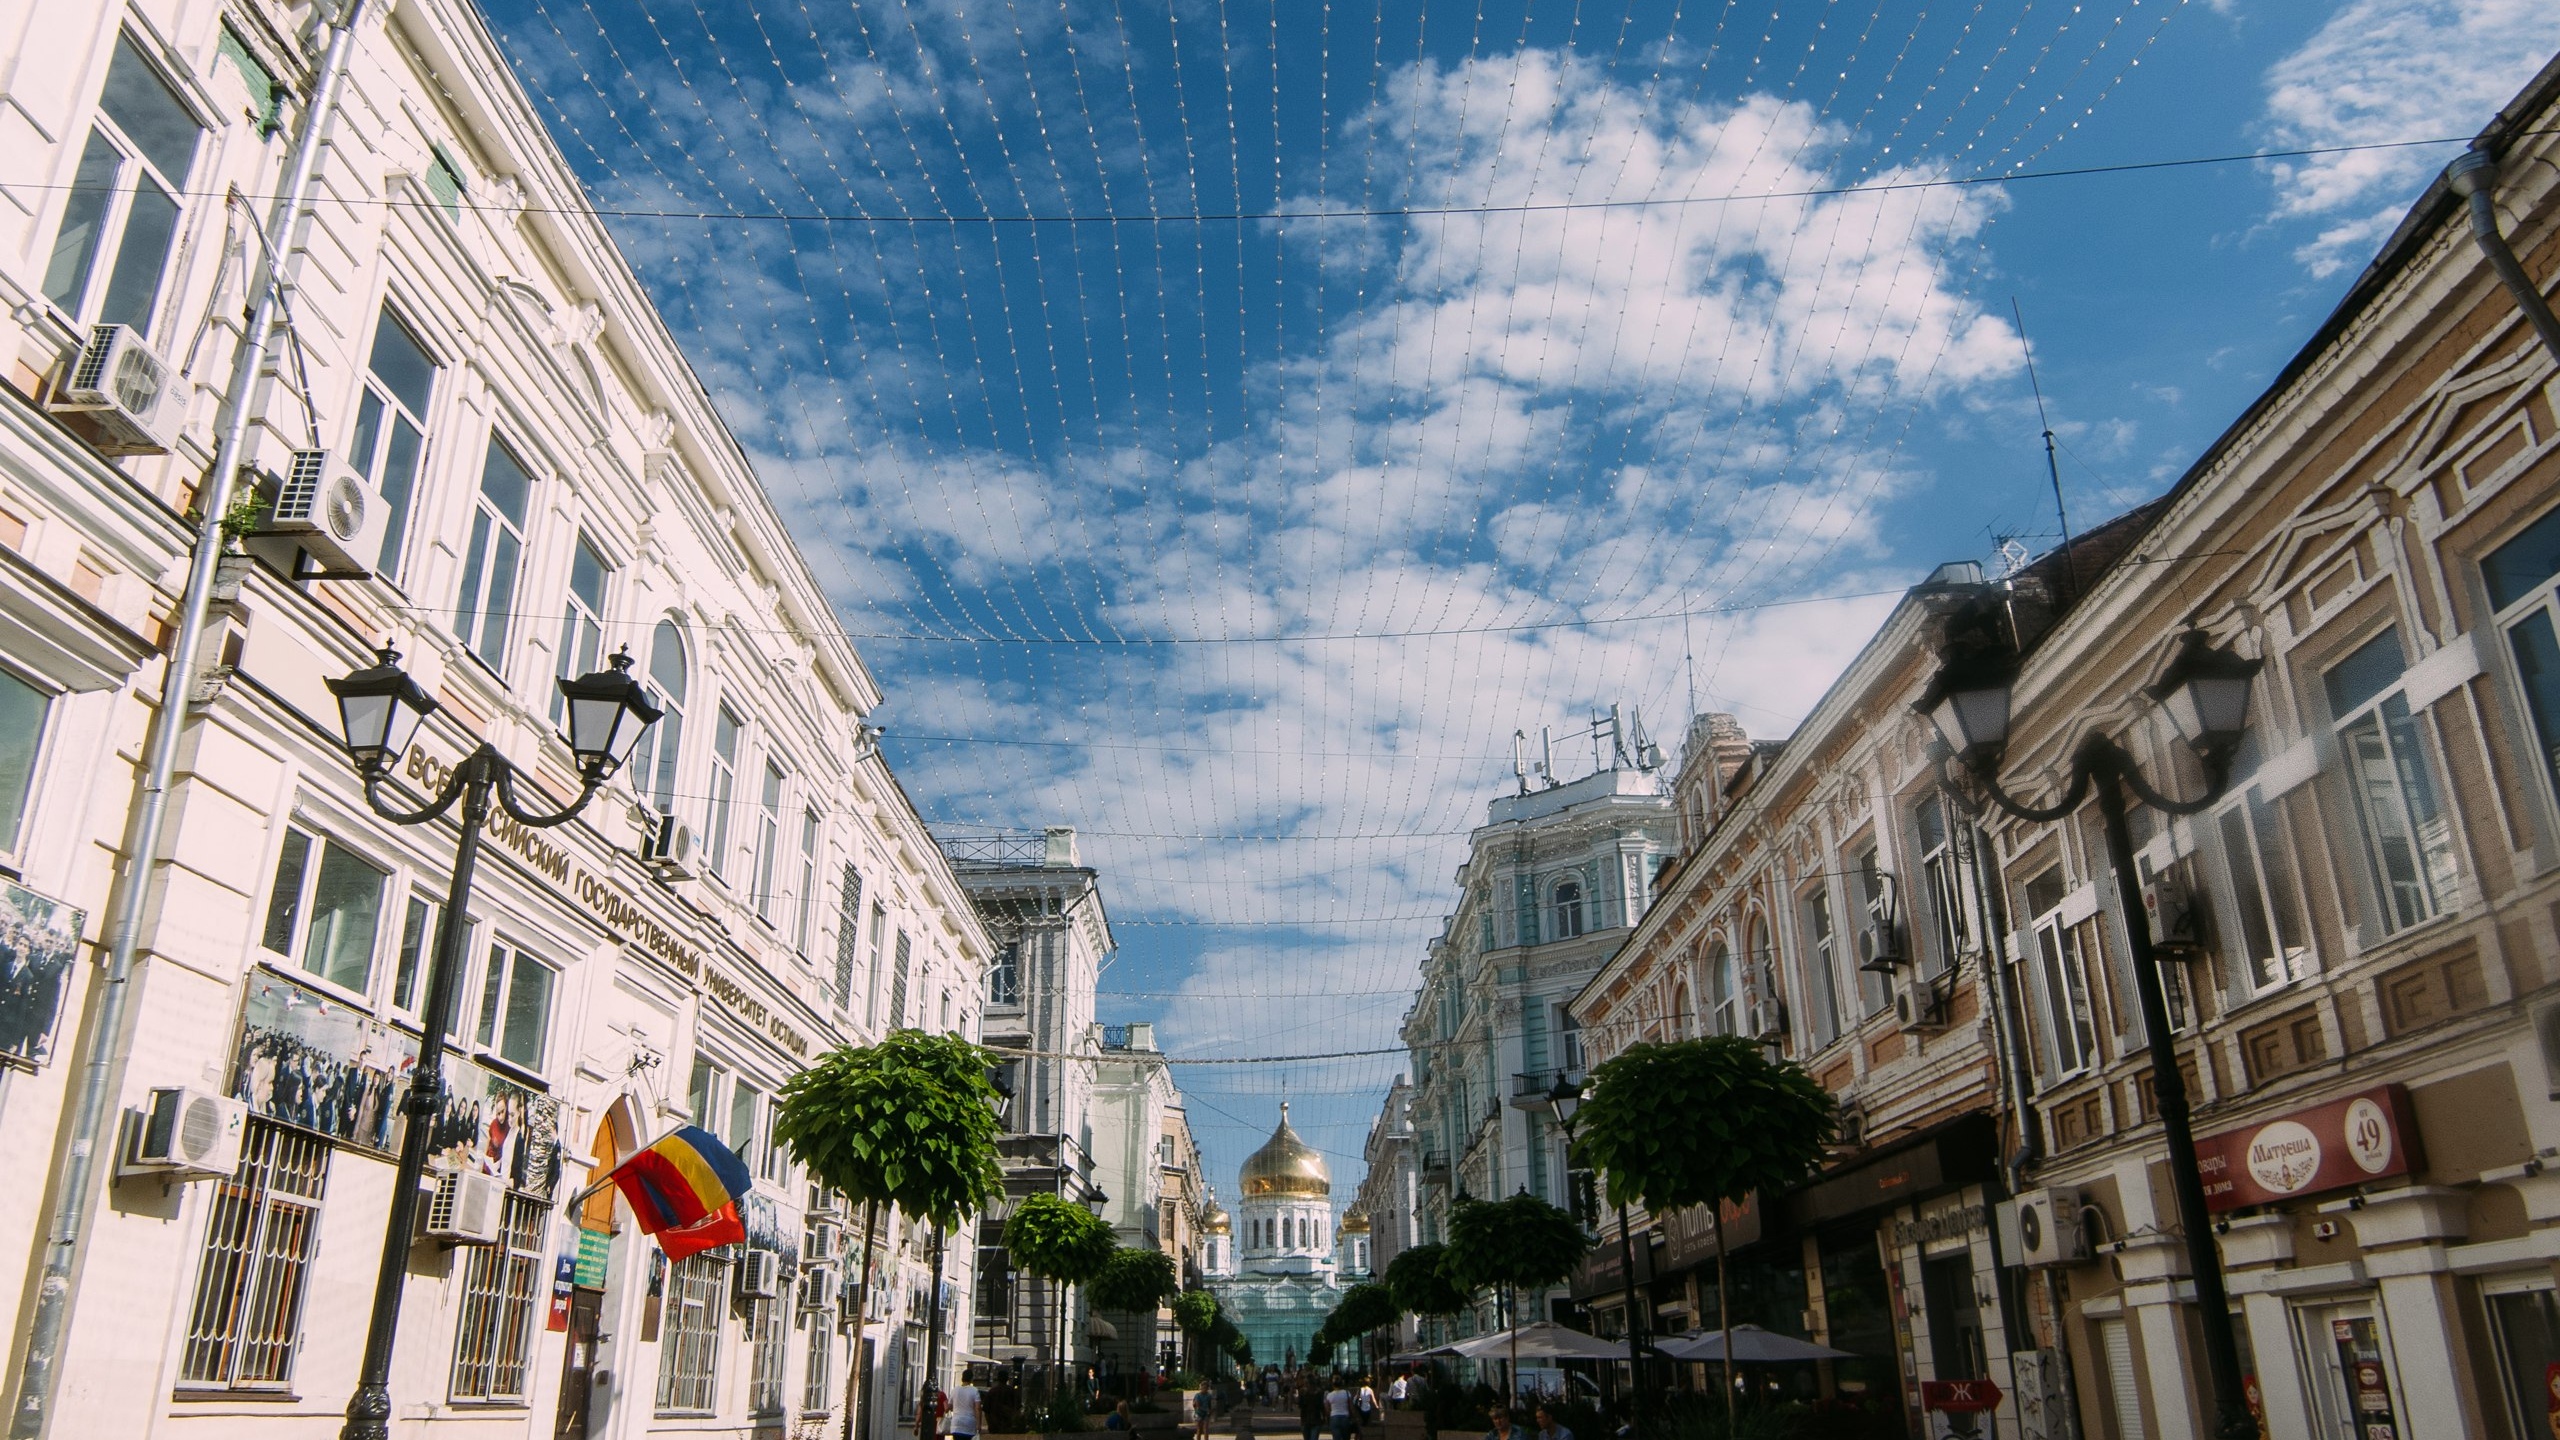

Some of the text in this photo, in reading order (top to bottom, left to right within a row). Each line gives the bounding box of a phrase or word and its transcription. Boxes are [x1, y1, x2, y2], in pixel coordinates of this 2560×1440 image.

[407, 743, 809, 1060] ВСЕСИЙСКИЙ ГОСУДАРСТВЕННЫЙ УНИВЕРСИТЕТ ЮСТИЦИИ
[2356, 1118, 2381, 1152] 49
[2196, 1154, 2227, 1175] овары
[2253, 1137, 2312, 1165] Матреша
[1949, 1382, 1973, 1401] Ж
